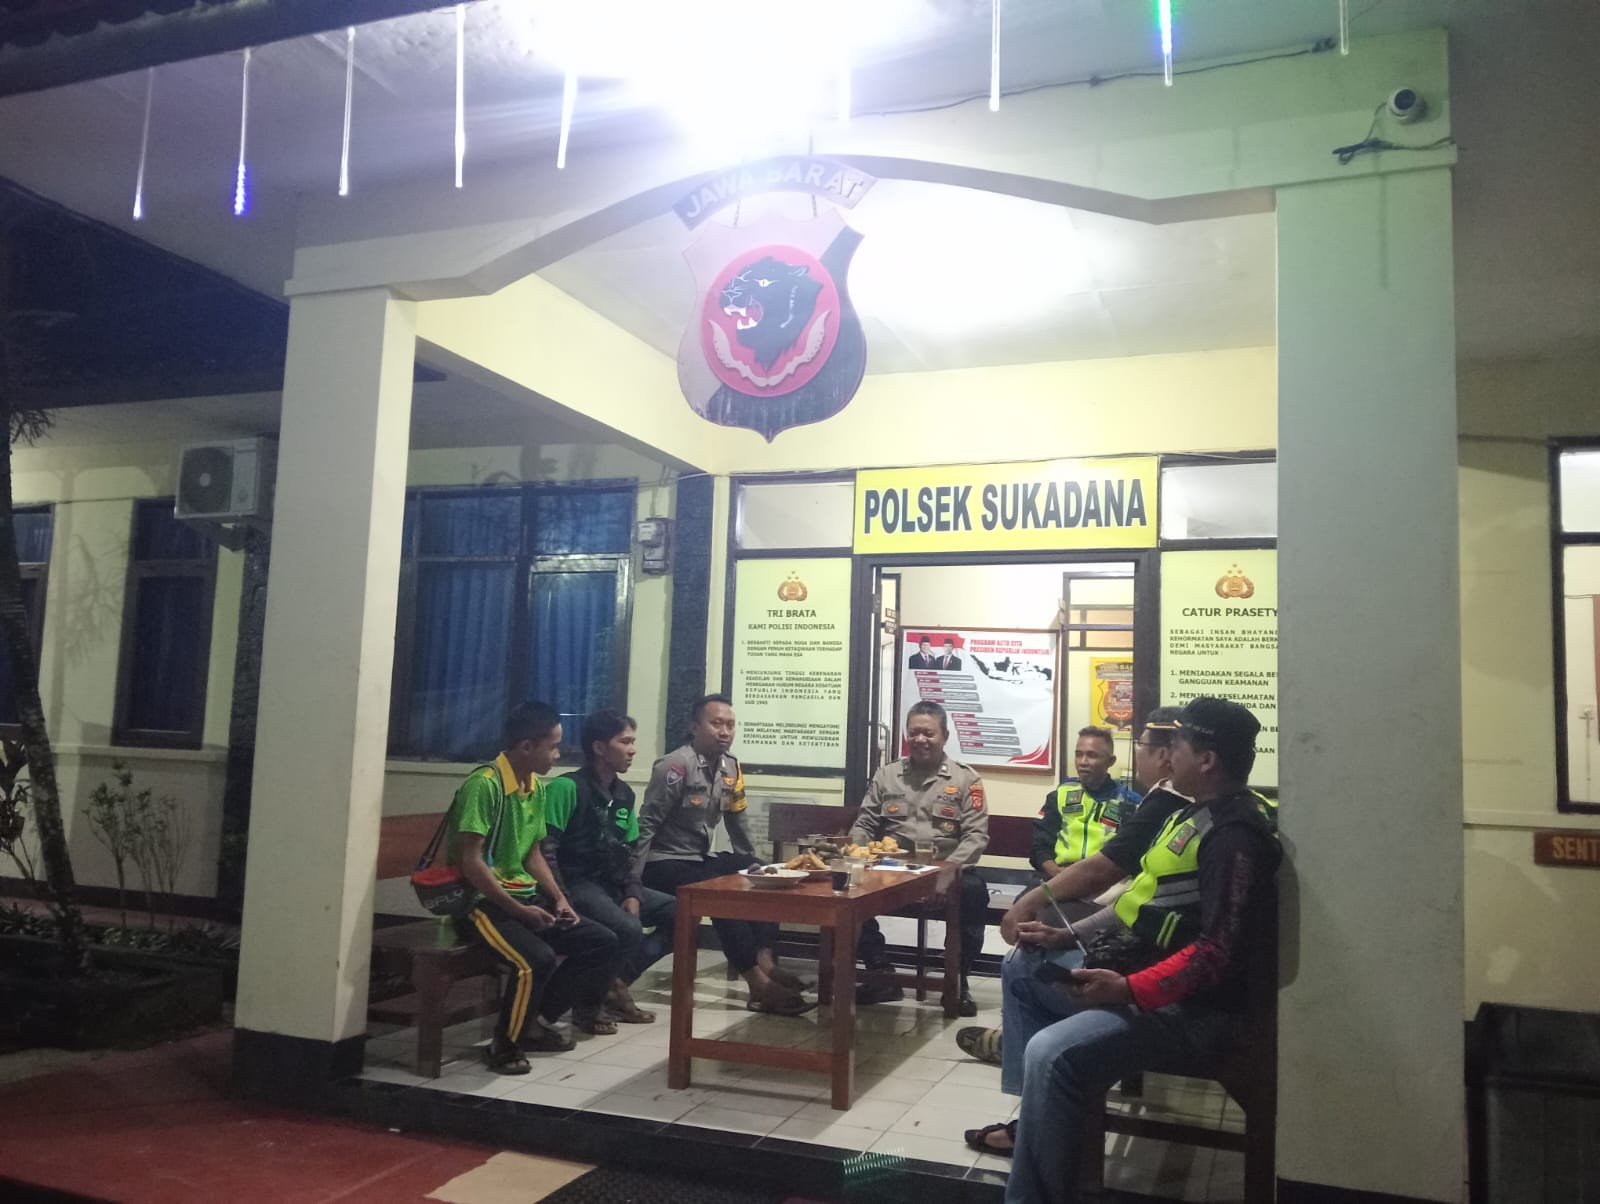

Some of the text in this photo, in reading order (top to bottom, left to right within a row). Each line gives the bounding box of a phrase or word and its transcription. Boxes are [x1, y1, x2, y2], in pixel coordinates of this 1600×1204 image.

[686, 163, 865, 218] JAWA BARAT
[864, 478, 1147, 534] POLSEK SUKADANA
[767, 609, 817, 618] TRI BRATA
[1182, 608, 1222, 617] CATUR
